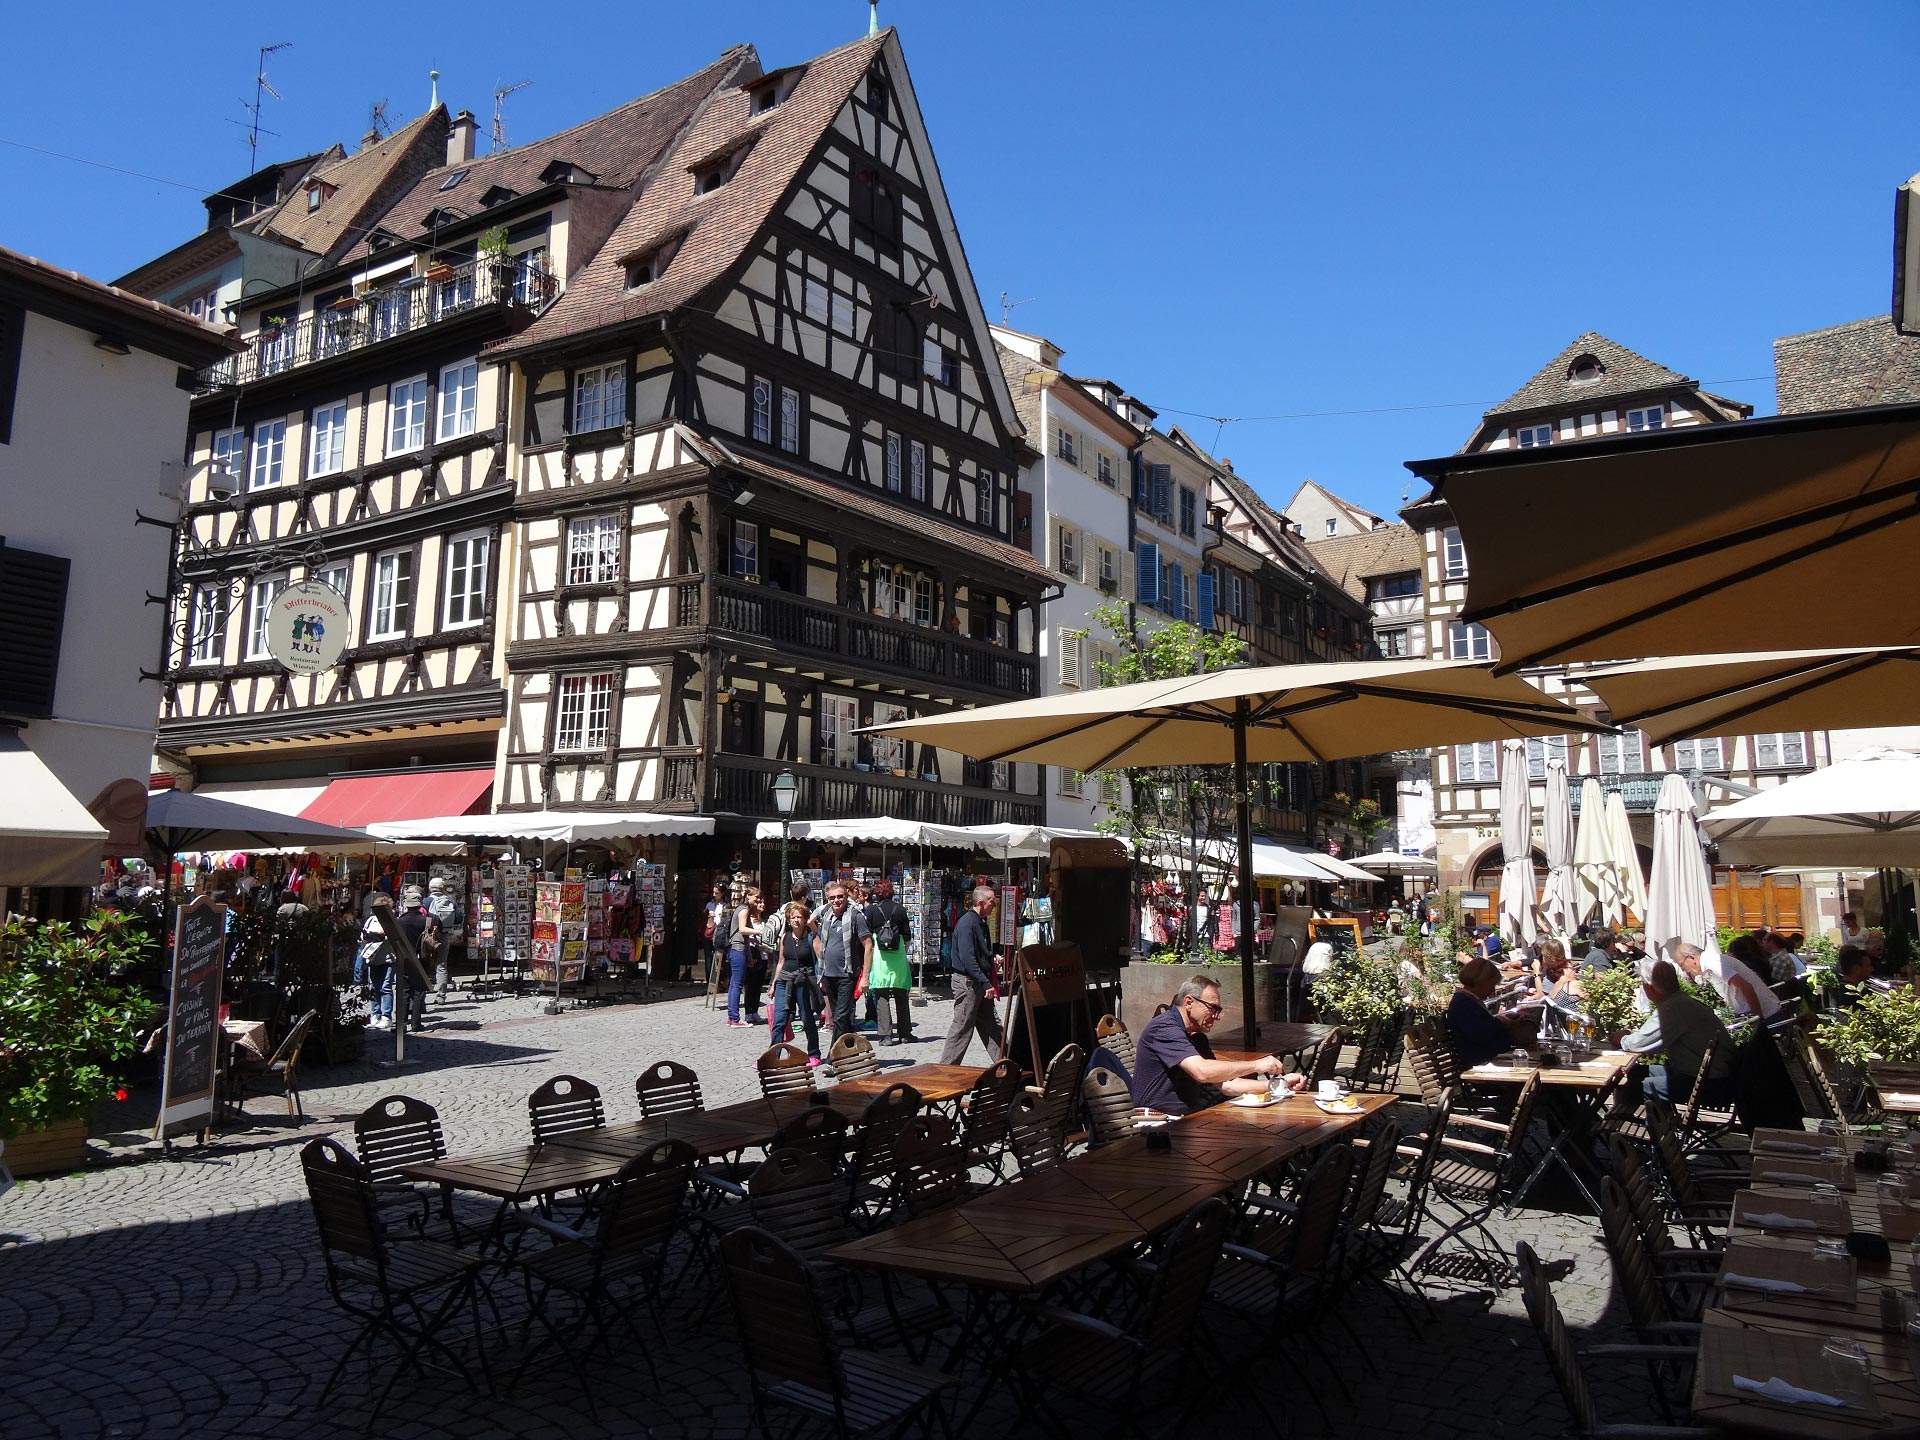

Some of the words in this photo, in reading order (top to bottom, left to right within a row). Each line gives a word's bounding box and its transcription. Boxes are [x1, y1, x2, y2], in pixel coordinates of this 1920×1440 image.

[289, 656, 320, 664] Restaurant
[760, 842, 775, 851] COIN
[176, 996, 204, 1017] CUISINE
[193, 1008, 210, 1024] VINS
[176, 1033, 186, 1048] DU
[187, 1020, 213, 1040] TERROIR
